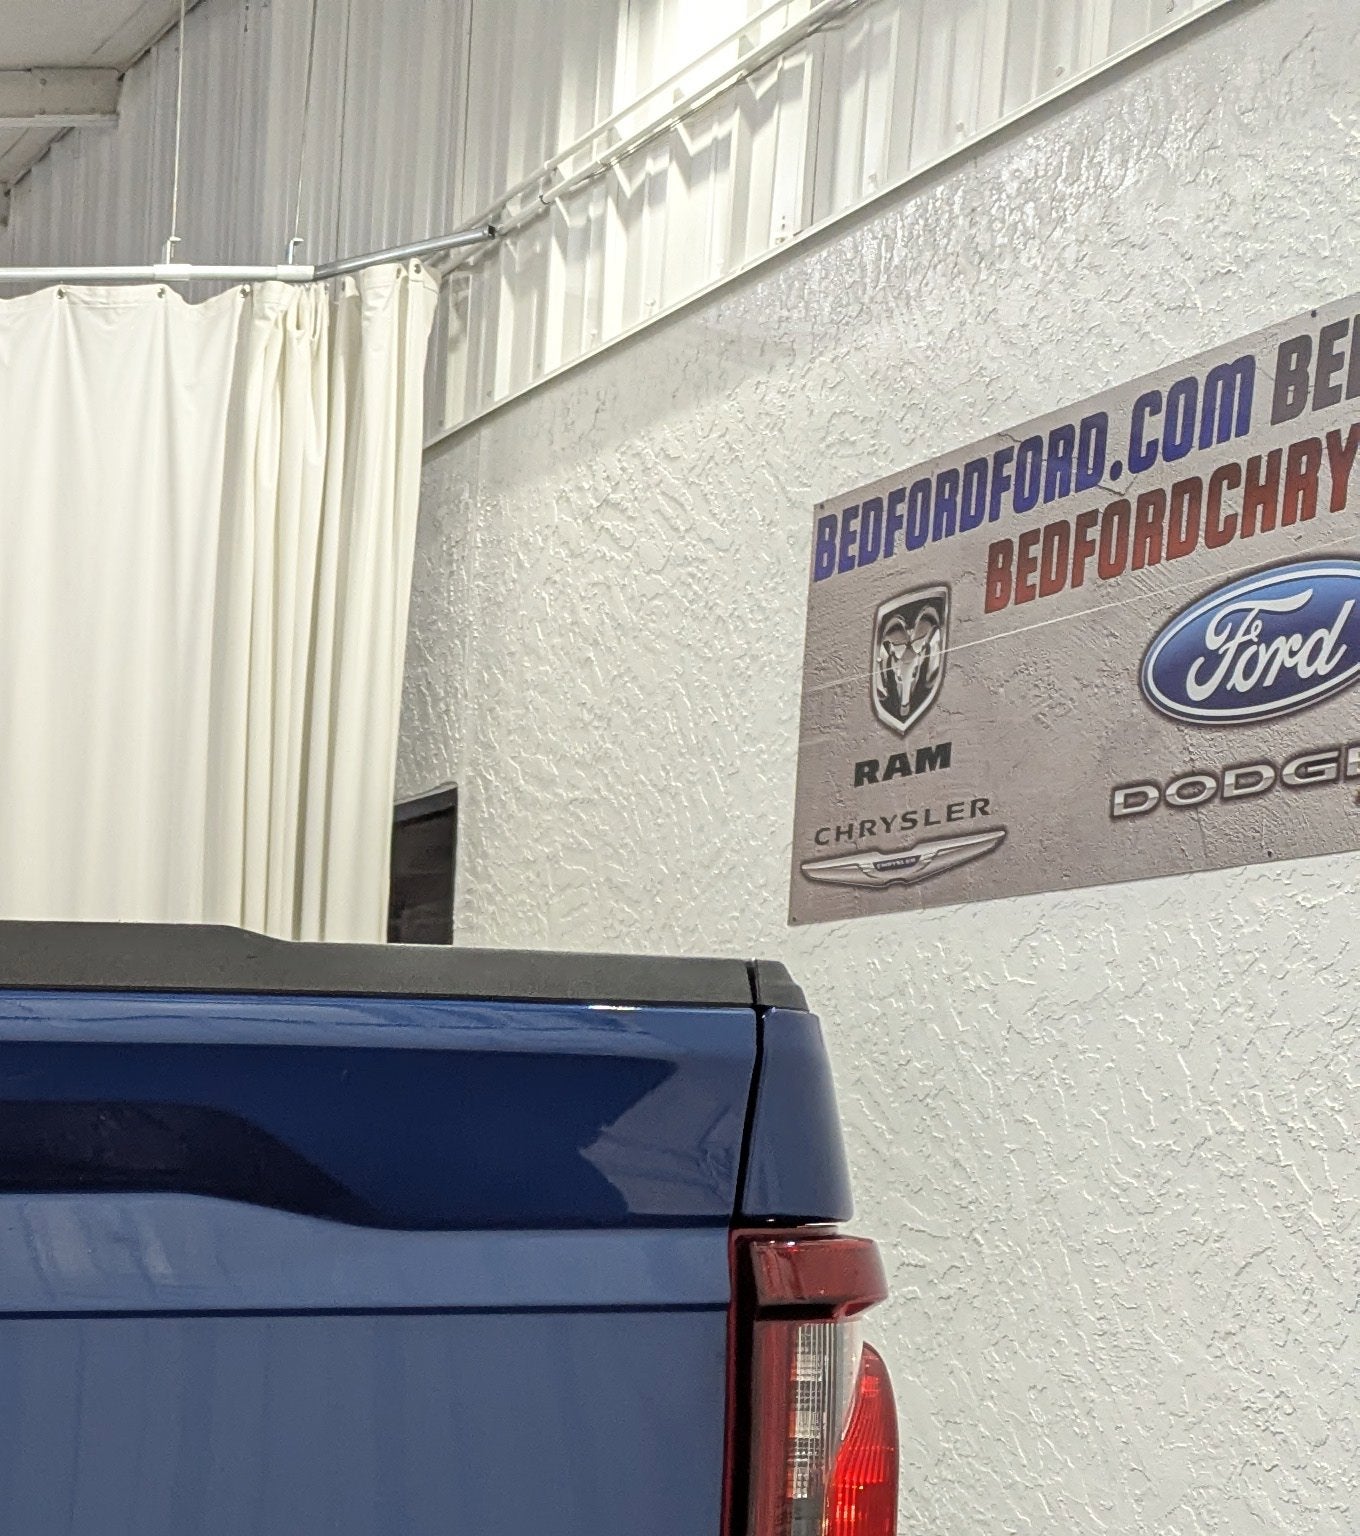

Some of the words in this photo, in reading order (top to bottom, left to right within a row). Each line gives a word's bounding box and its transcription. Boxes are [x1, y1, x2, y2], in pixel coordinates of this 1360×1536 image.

[814, 354, 1256, 582] BEDFORDFORD.COM
[984, 422, 1360, 613] BEDFORDCHRY
[1186, 588, 1356, 701] Ford
[854, 742, 952, 787] RAM
[1113, 747, 1360, 816] DODG
[814, 798, 991, 845] CHRYSLER
